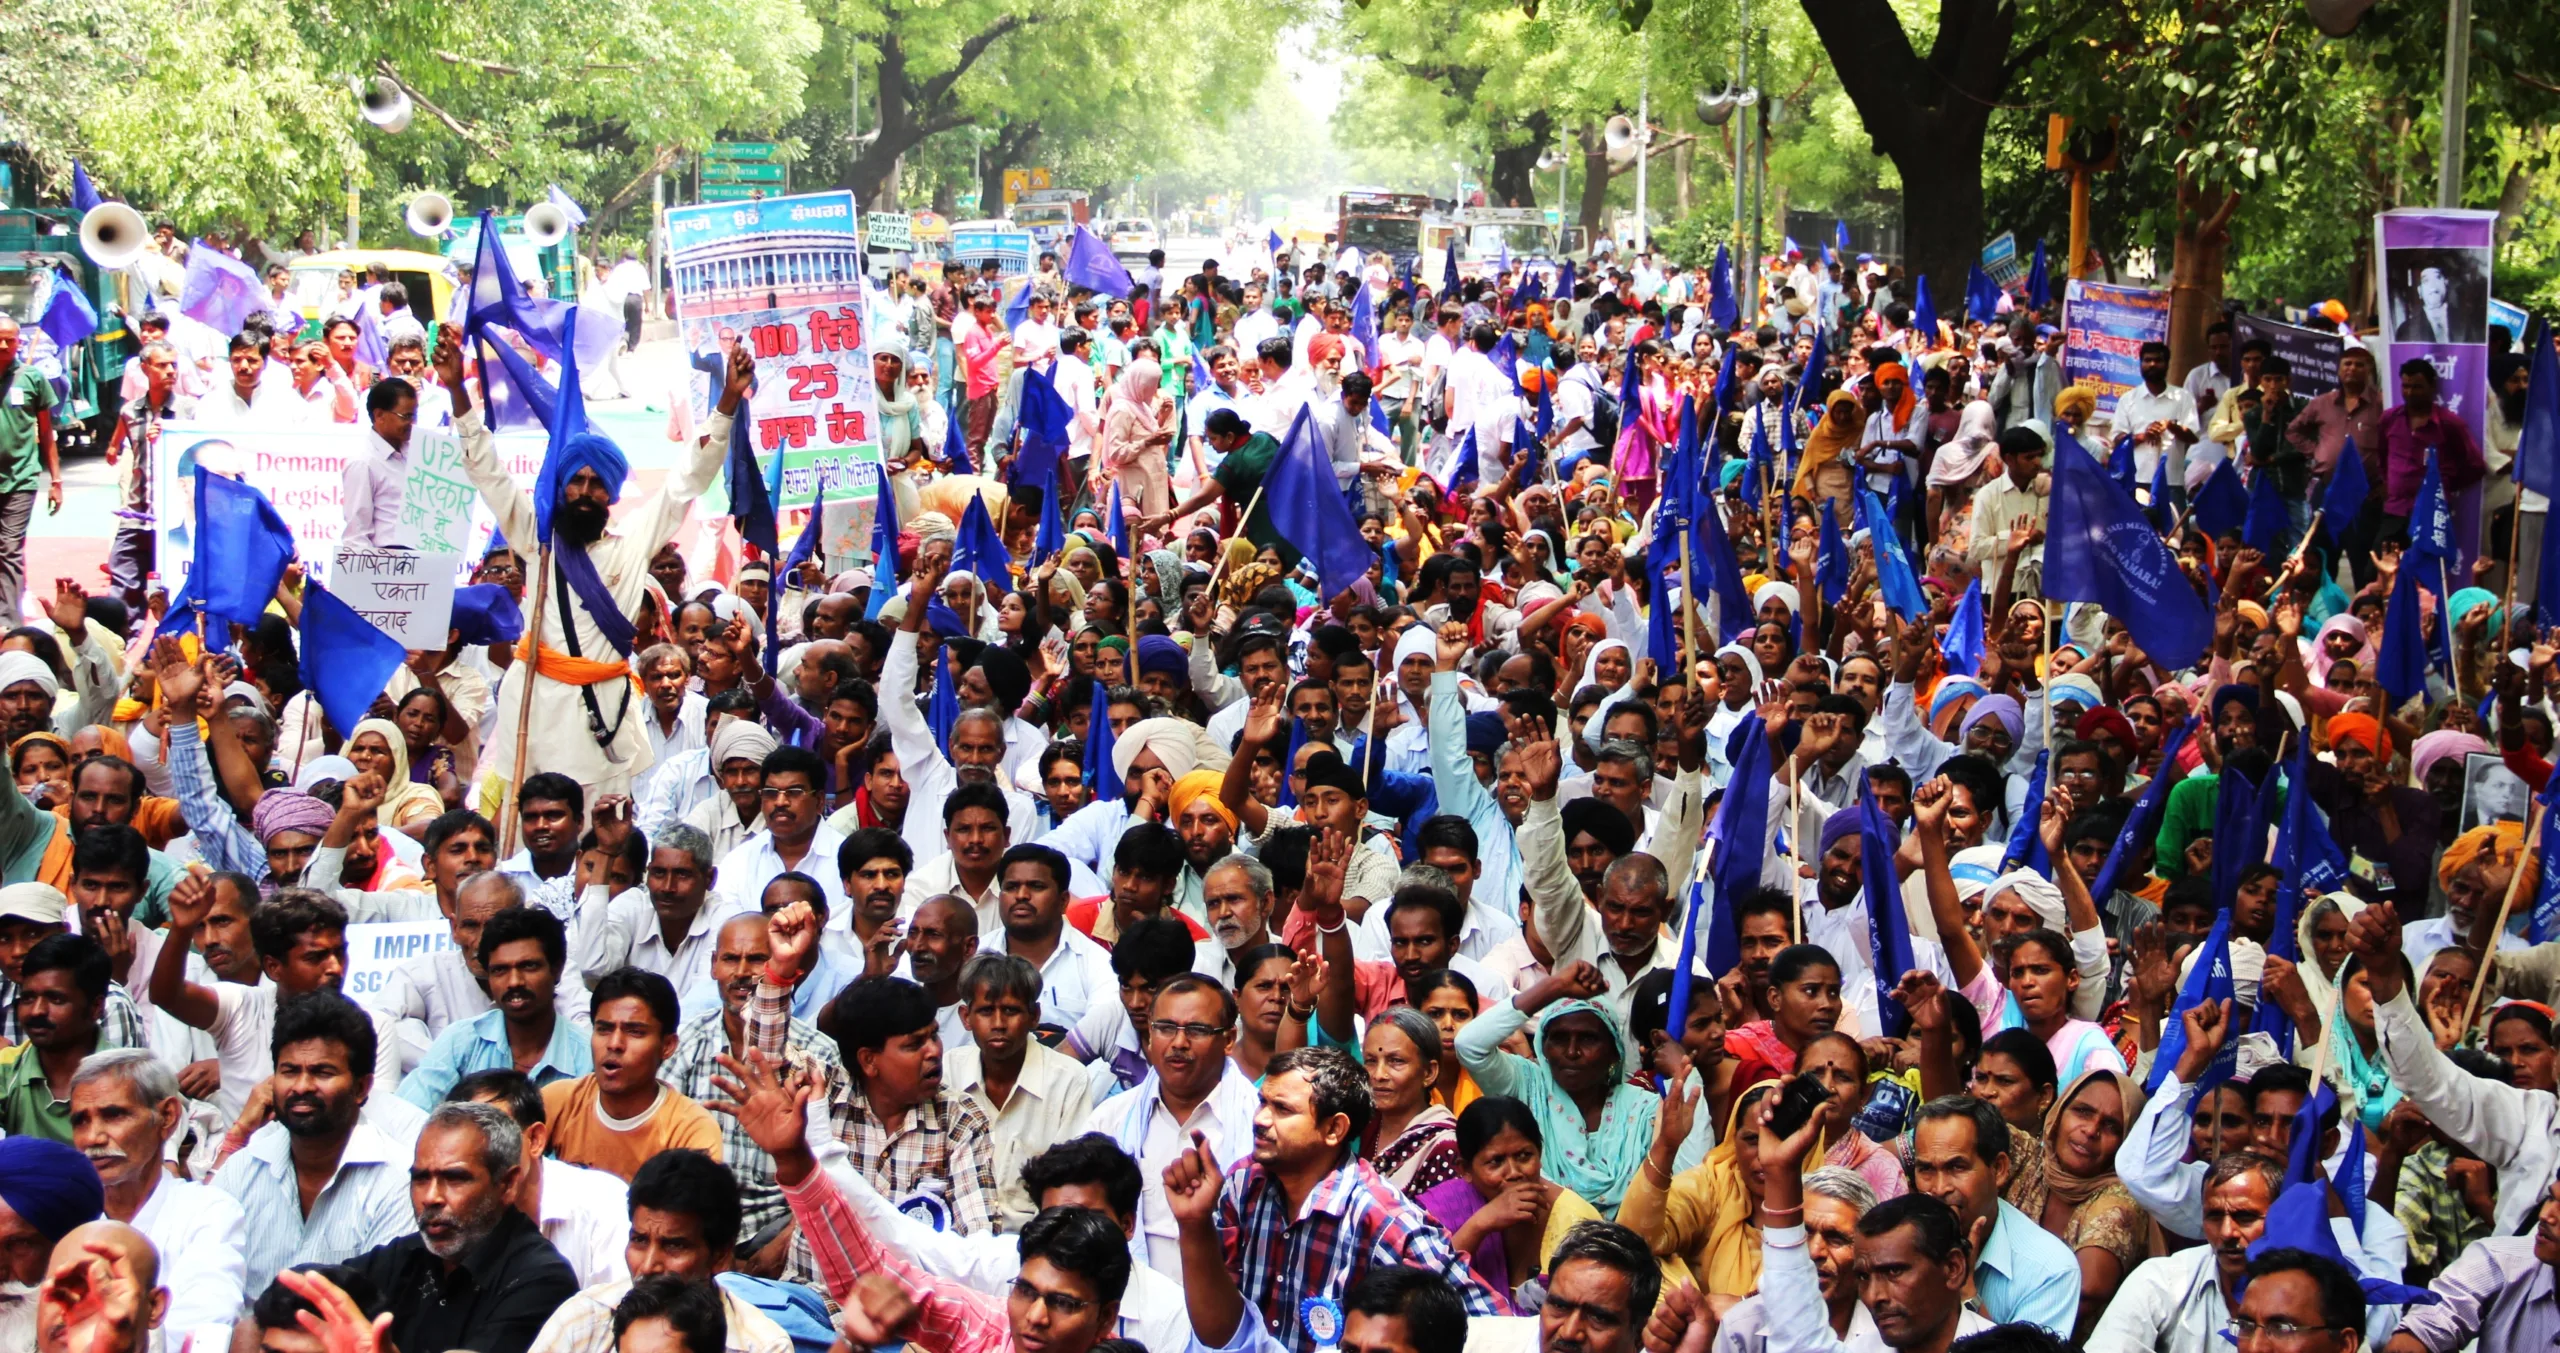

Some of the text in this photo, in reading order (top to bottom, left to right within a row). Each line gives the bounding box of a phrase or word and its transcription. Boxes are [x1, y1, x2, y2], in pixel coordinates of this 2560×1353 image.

[869, 213, 909, 225] WE WANT
[749, 323, 799, 359] 100
[786, 363, 839, 402] 25
[302, 518, 338, 540] the
[371, 582, 430, 602] एकता
